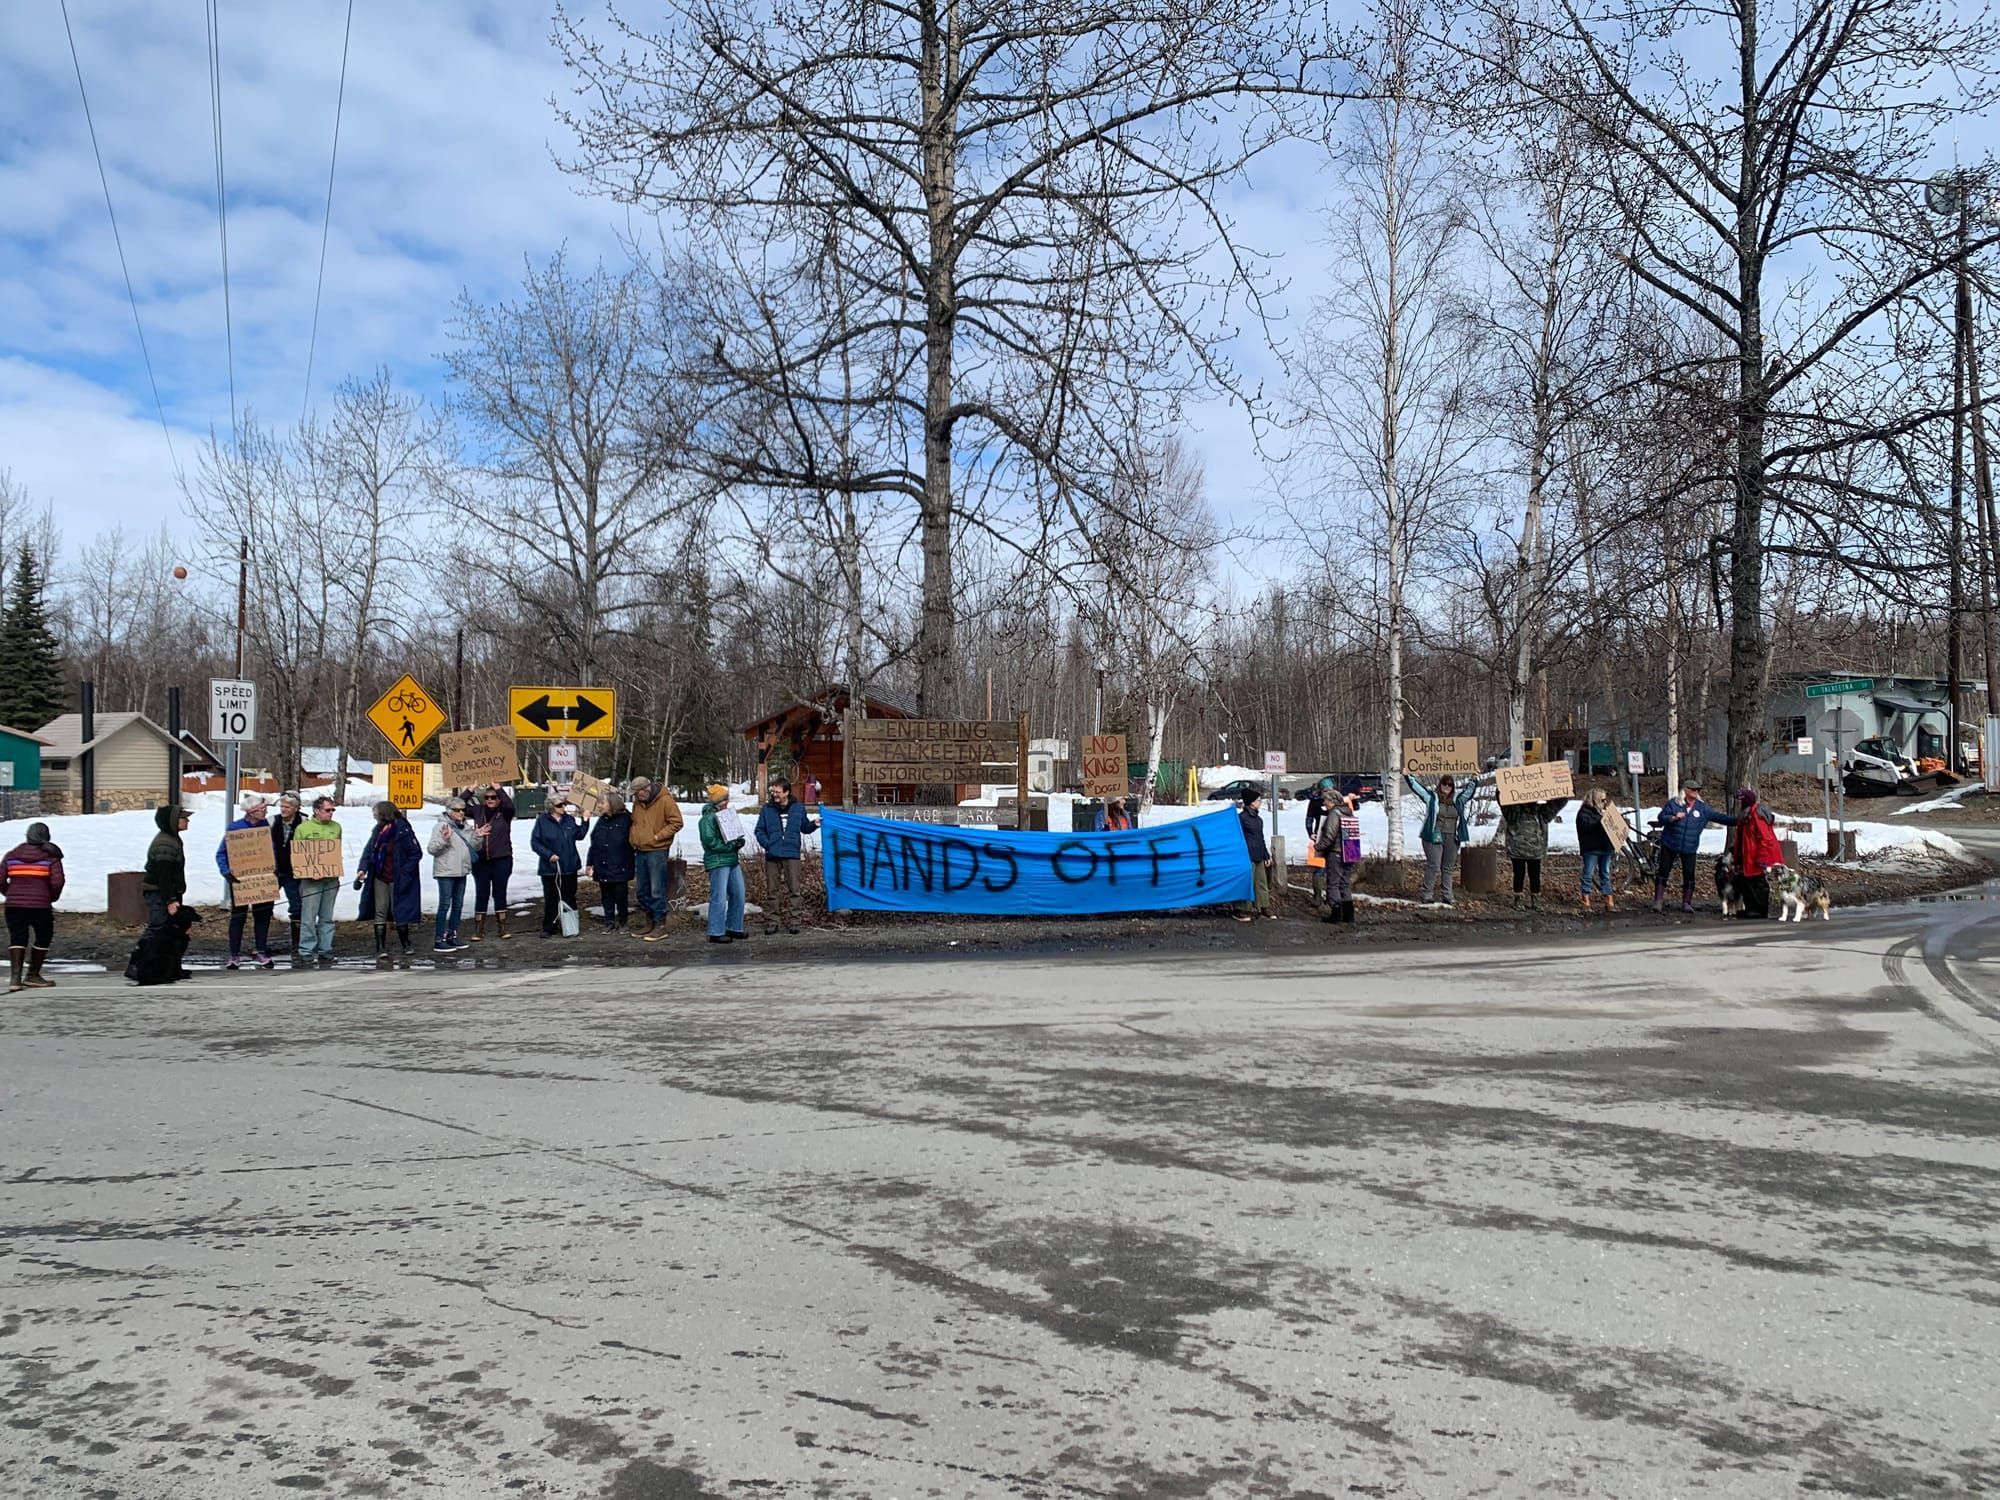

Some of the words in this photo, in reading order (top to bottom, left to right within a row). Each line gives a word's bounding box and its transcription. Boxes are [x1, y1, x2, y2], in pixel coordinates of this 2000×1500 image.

[215, 686, 252, 697] SPEED
[1821, 683, 1854, 693] TALKEETNA
[219, 699, 248, 709] LIMIT
[220, 712, 246, 734] 10
[886, 721, 988, 739] ENTERING
[466, 734, 489, 746] SAVE
[1092, 736, 1118, 753] NO
[472, 745, 490, 754] OUR
[557, 749, 568, 757] NO
[880, 743, 997, 760] TALKEETNA
[1414, 739, 1455, 756] Uphold
[451, 756, 505, 773] DEMOCRACY
[1271, 754, 1280, 762] NO
[1408, 758, 1476, 772] Constitution
[391, 765, 421, 775] SHARE
[1084, 756, 1120, 778] KINGS
[456, 769, 509, 783] CONSTITUTION
[863, 767, 932, 781] HISTORIC
[943, 768, 1009, 782] DISTRICT
[1503, 766, 1544, 784] Protect
[398, 780, 414, 789] THE
[1095, 783, 1120, 794] DOGE!
[394, 794, 417, 804] ROAD
[1510, 786, 1569, 802] Democracy
[880, 809, 940, 822] VILLAGE
[957, 810, 994, 822] PARK
[292, 839, 336, 854] UNITED
[304, 852, 326, 866] WE
[831, 832, 1017, 893] HANDS
[1050, 826, 1204, 888] OFF!
[294, 864, 341, 877] STAND
